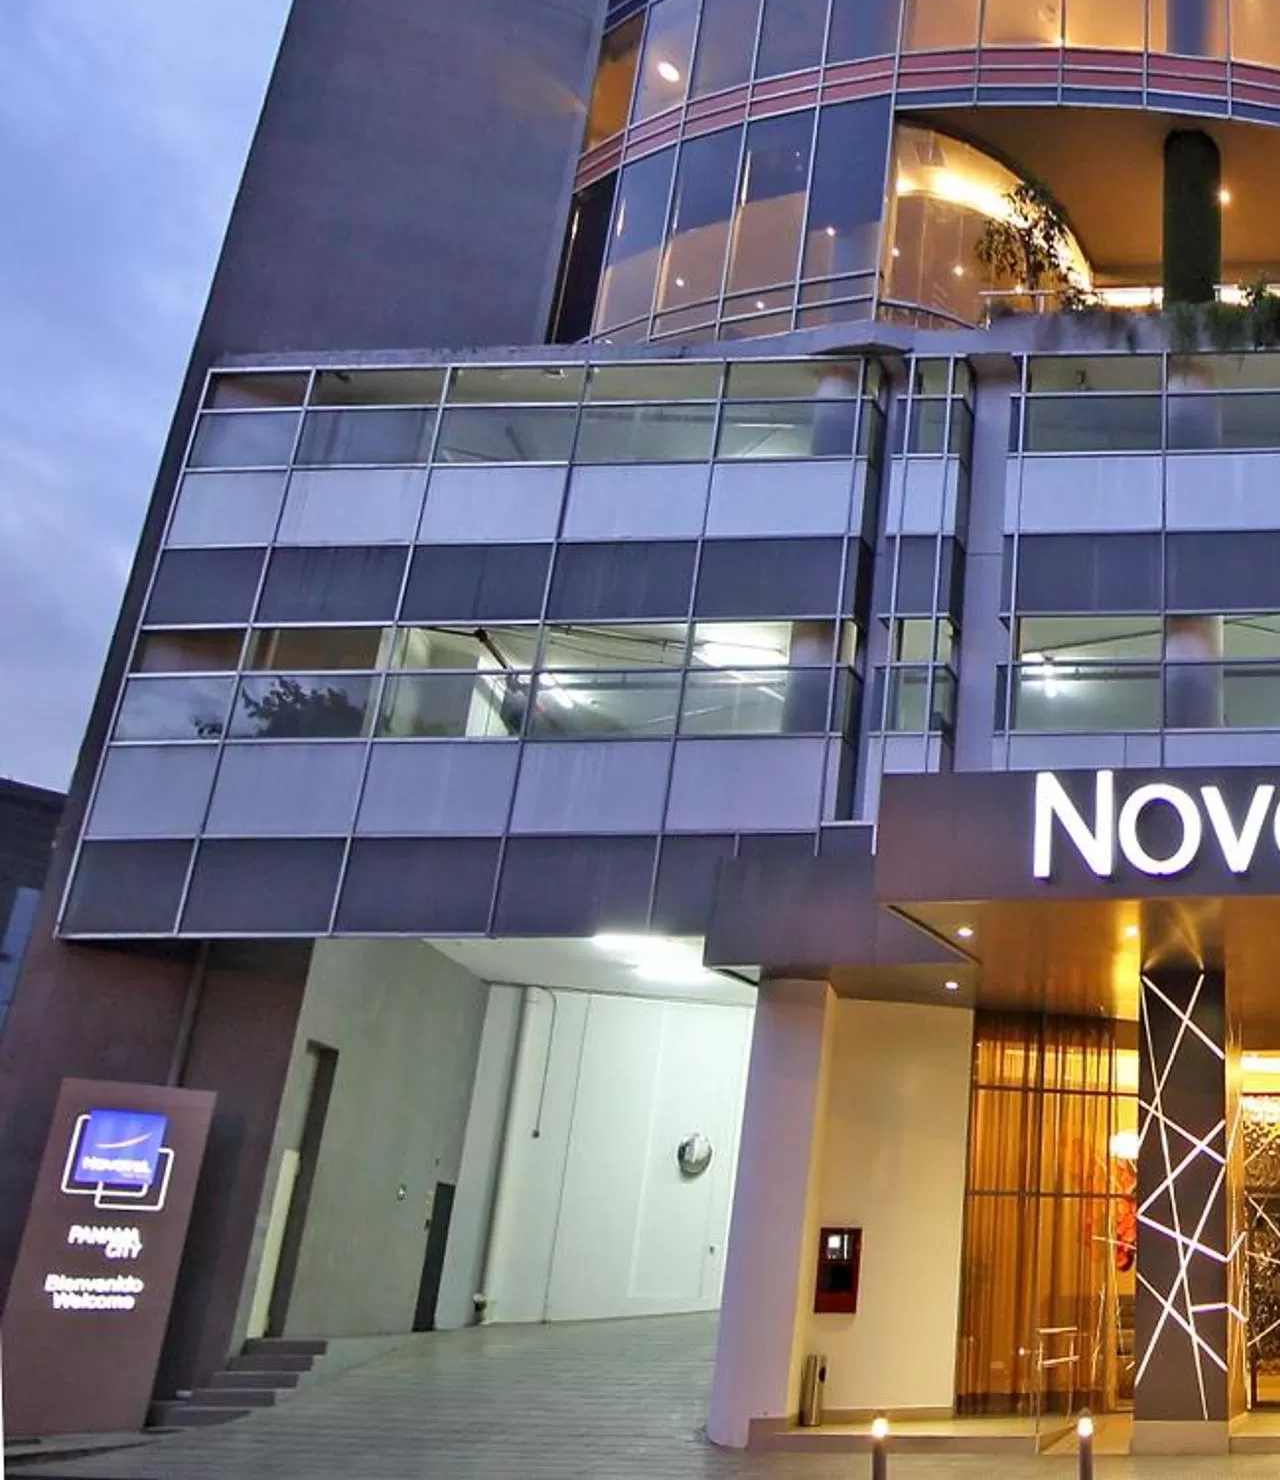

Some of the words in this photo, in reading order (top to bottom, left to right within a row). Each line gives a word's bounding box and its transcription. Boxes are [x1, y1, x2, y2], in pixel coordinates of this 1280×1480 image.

[68, 1225, 140, 1246] PANAMA
[105, 1241, 143, 1258] CITY
[53, 1291, 135, 1309] Welcome
